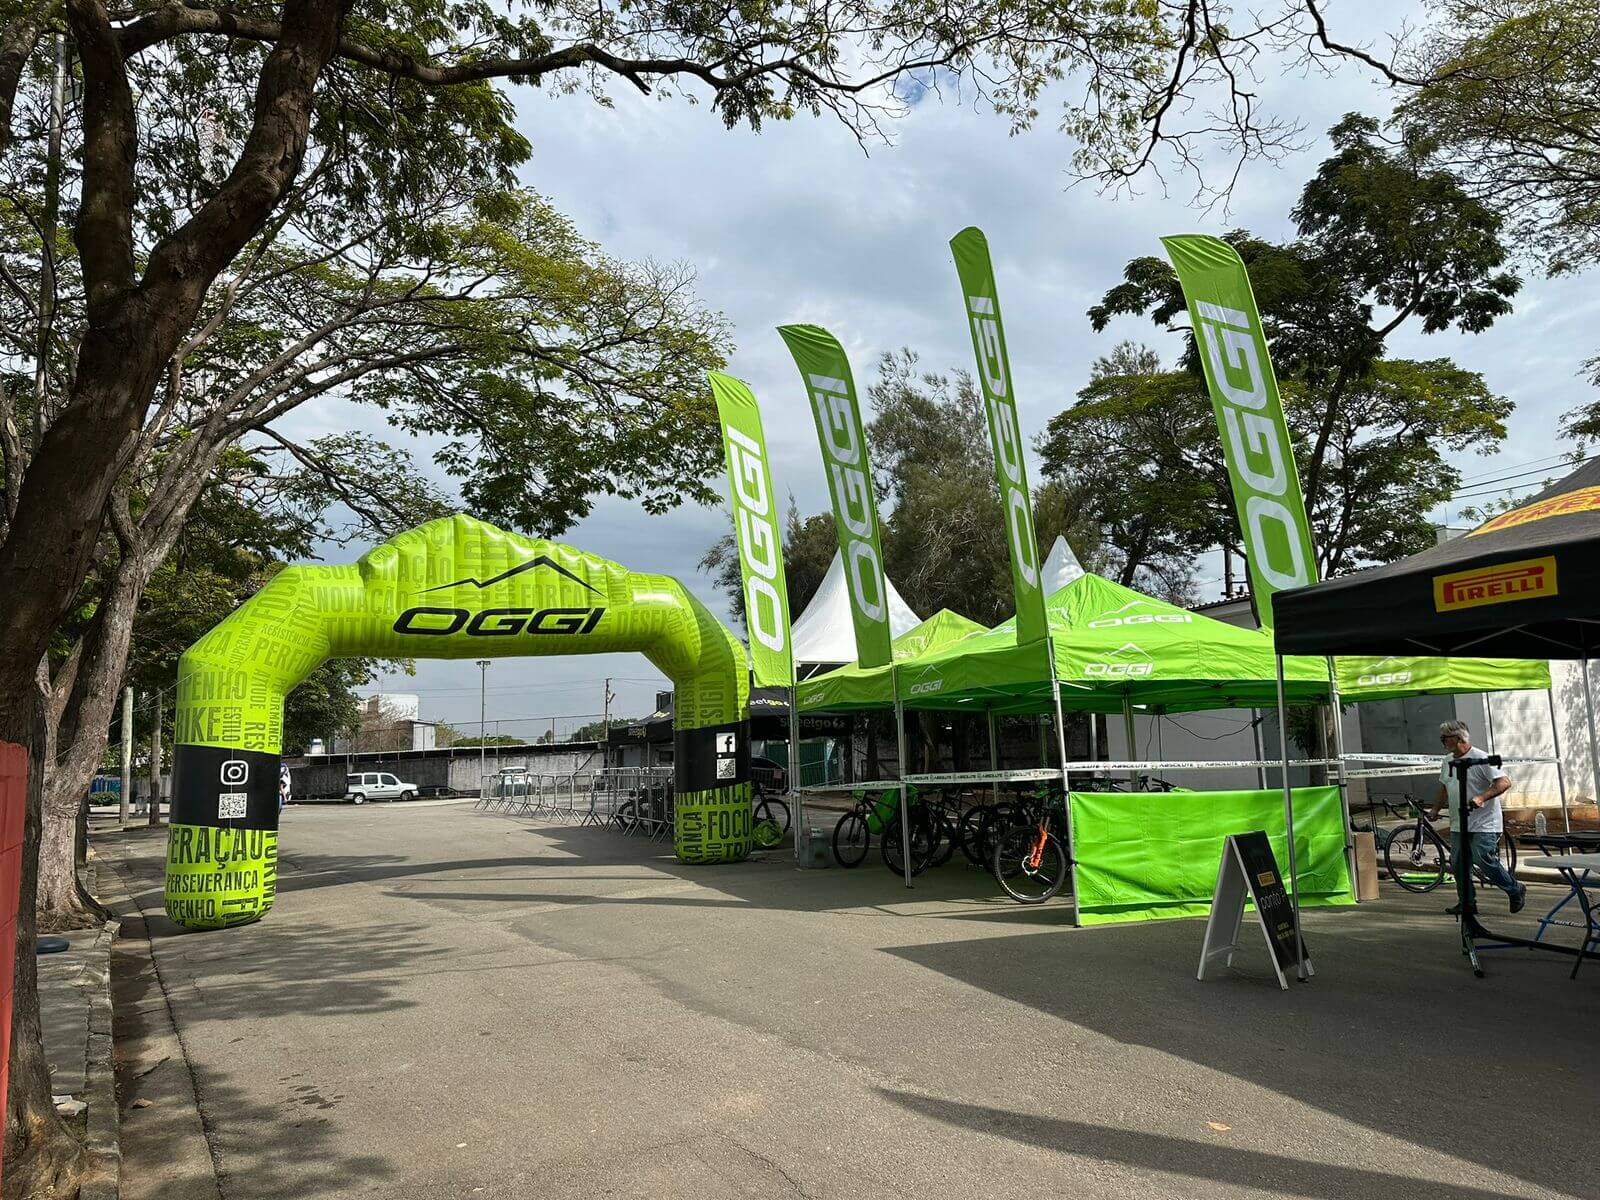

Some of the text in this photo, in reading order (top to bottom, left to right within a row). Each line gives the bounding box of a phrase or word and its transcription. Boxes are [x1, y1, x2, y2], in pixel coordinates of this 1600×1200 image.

[968, 295, 1038, 590] OGGI
[1195, 299, 1309, 590] OGGI
[808, 373, 886, 623] OGGI
[727, 423, 784, 652] OGGI
[1443, 565, 1545, 604] PIRELLI
[392, 606, 607, 637] OGGI
[1088, 614, 1193, 629] OGGI
[1084, 663, 1155, 676] OGGI
[1357, 671, 1411, 687] OGGI
[803, 692, 826, 705] OGGI
[910, 679, 943, 695] OGGI
[707, 808, 749, 840] FOCO
[166, 870, 259, 894] PERSEVERANÇA
